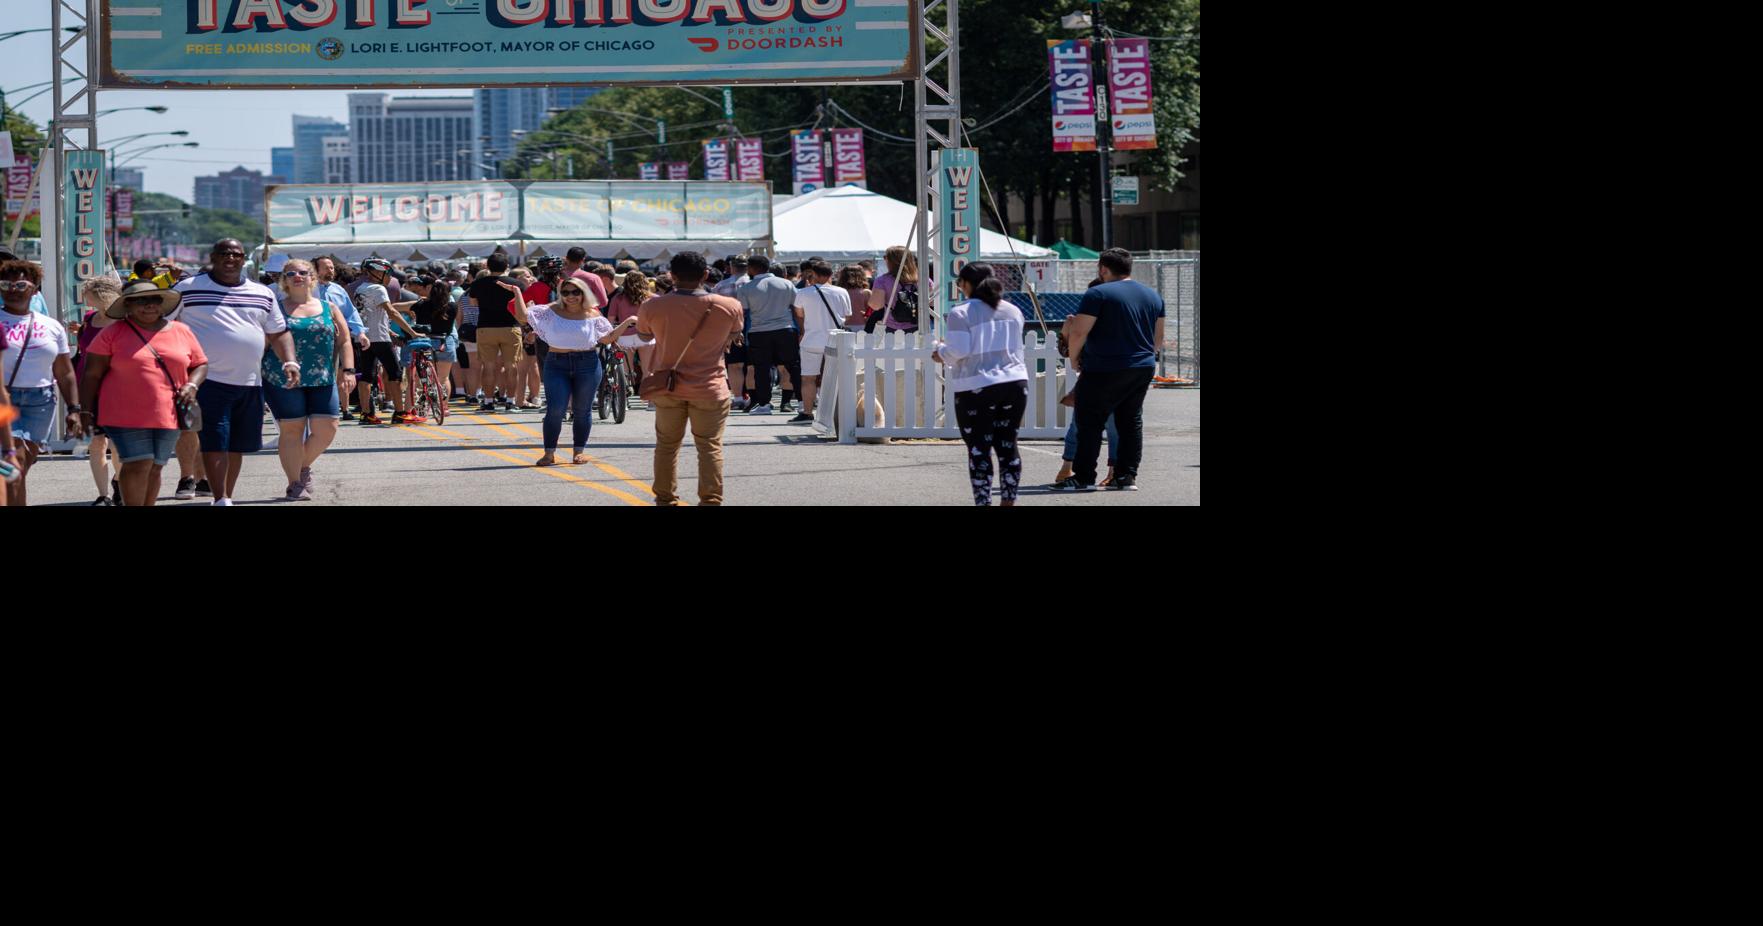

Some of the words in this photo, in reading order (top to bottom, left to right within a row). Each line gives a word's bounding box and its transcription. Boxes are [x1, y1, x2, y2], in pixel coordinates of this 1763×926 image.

[727, 26, 816, 36] PRESENTED
[826, 25, 844, 33] BY
[186, 44, 223, 55] FREE
[226, 43, 312, 55] ADMISSION
[351, 43, 386, 54] LORI
[390, 43, 402, 53] E.
[406, 42, 496, 54] LIGHTFOOT,
[501, 41, 555, 52] MAYOR
[559, 41, 580, 51] OF
[584, 40, 655, 51] CHICAGO
[727, 36, 844, 50] DOORDASH
[1054, 46, 1090, 114] TASTE
[1111, 45, 1149, 113] TASTE
[1067, 121, 1092, 130] pepsi
[1127, 120, 1152, 129] pepsi
[795, 134, 821, 181] TASTE
[836, 132, 863, 180] TASTE
[304, 191, 504, 225] WELCOME
[529, 197, 591, 214] TASTE
[631, 198, 731, 213] CHICAGO
[1036, 268, 1043, 281] 1
[8, 329, 47, 341] Mre
